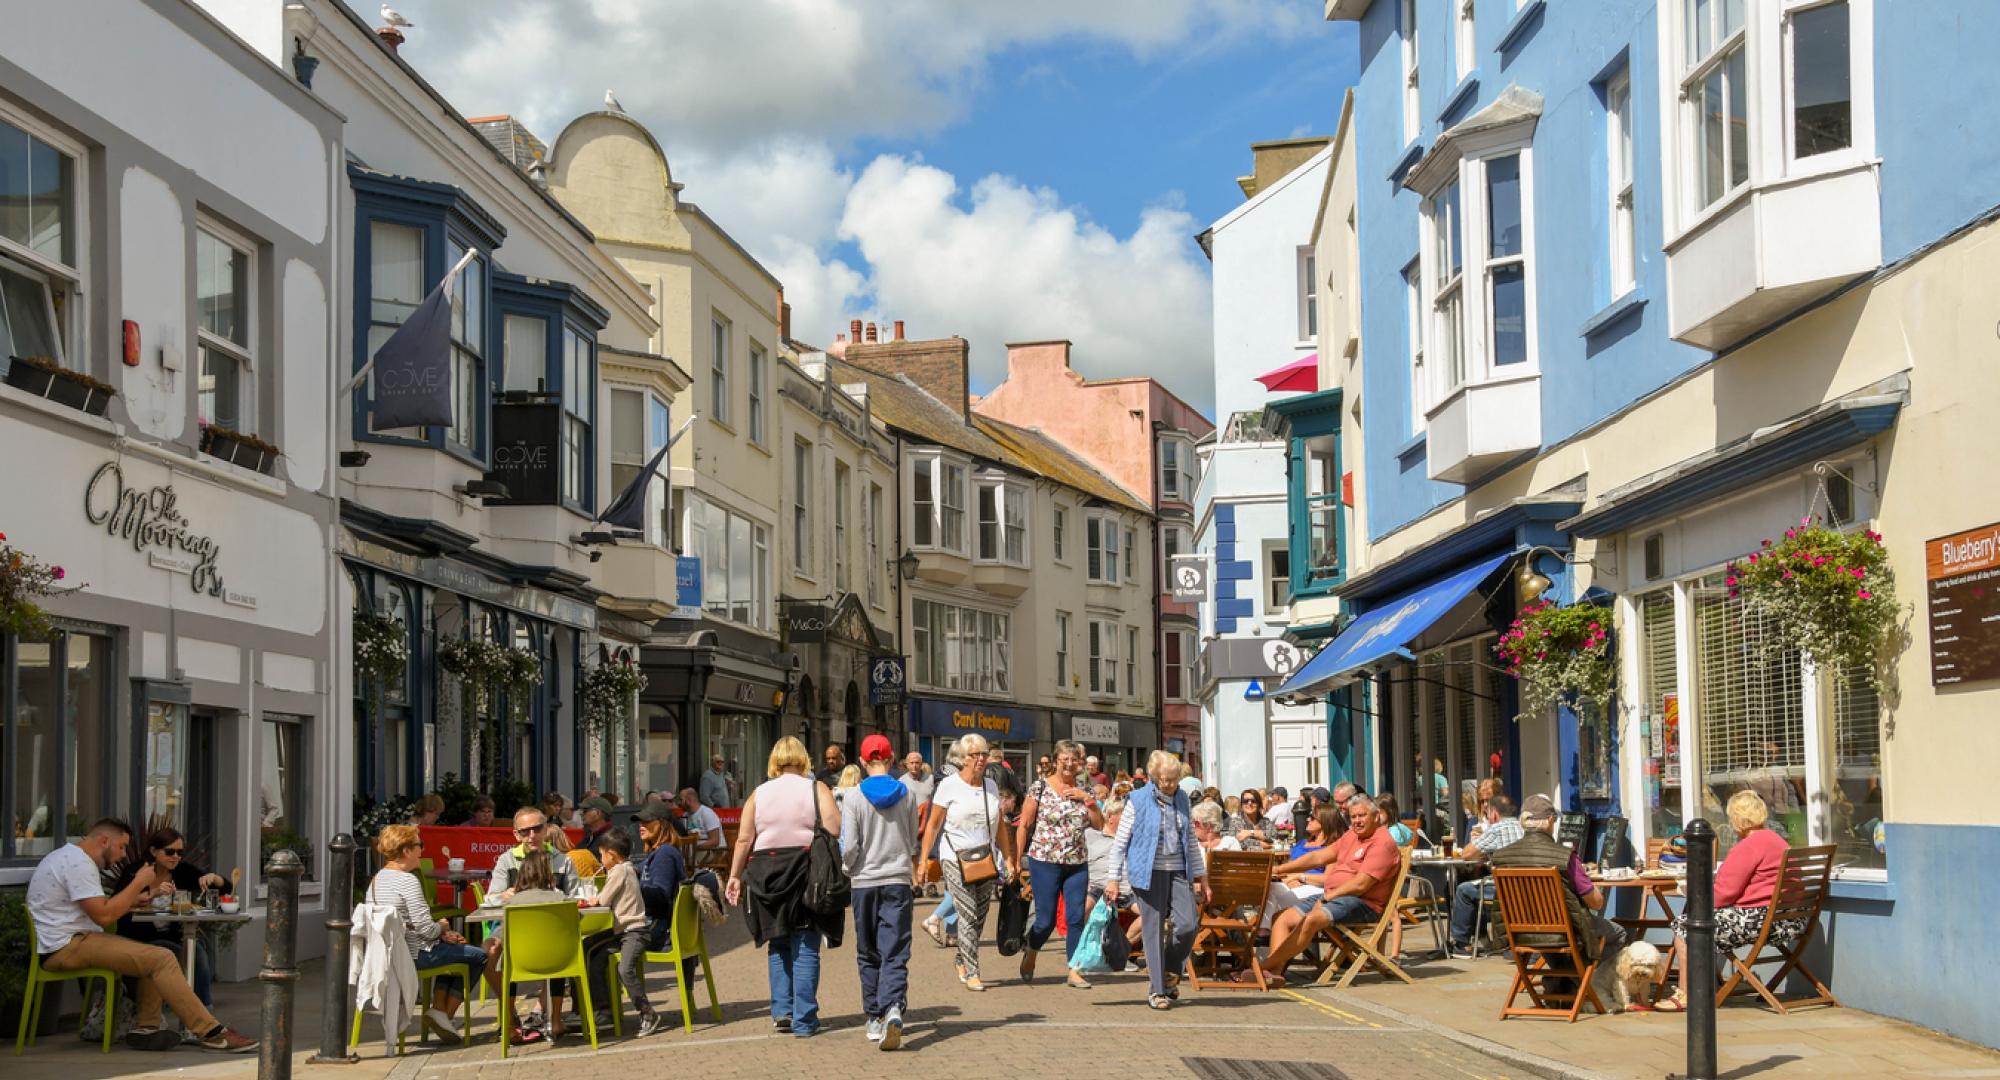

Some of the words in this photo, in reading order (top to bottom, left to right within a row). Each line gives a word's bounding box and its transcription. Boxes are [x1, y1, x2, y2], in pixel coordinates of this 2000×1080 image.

[382, 367, 438, 390] COVE
[494, 445, 548, 464] COVE
[150, 485, 182, 521] The
[789, 617, 825, 631] M&Co
[952, 709, 975, 729] Card
[977, 711, 1011, 735] Factory
[1074, 722, 1095, 737] NEW
[1097, 724, 1119, 739] LOOK
